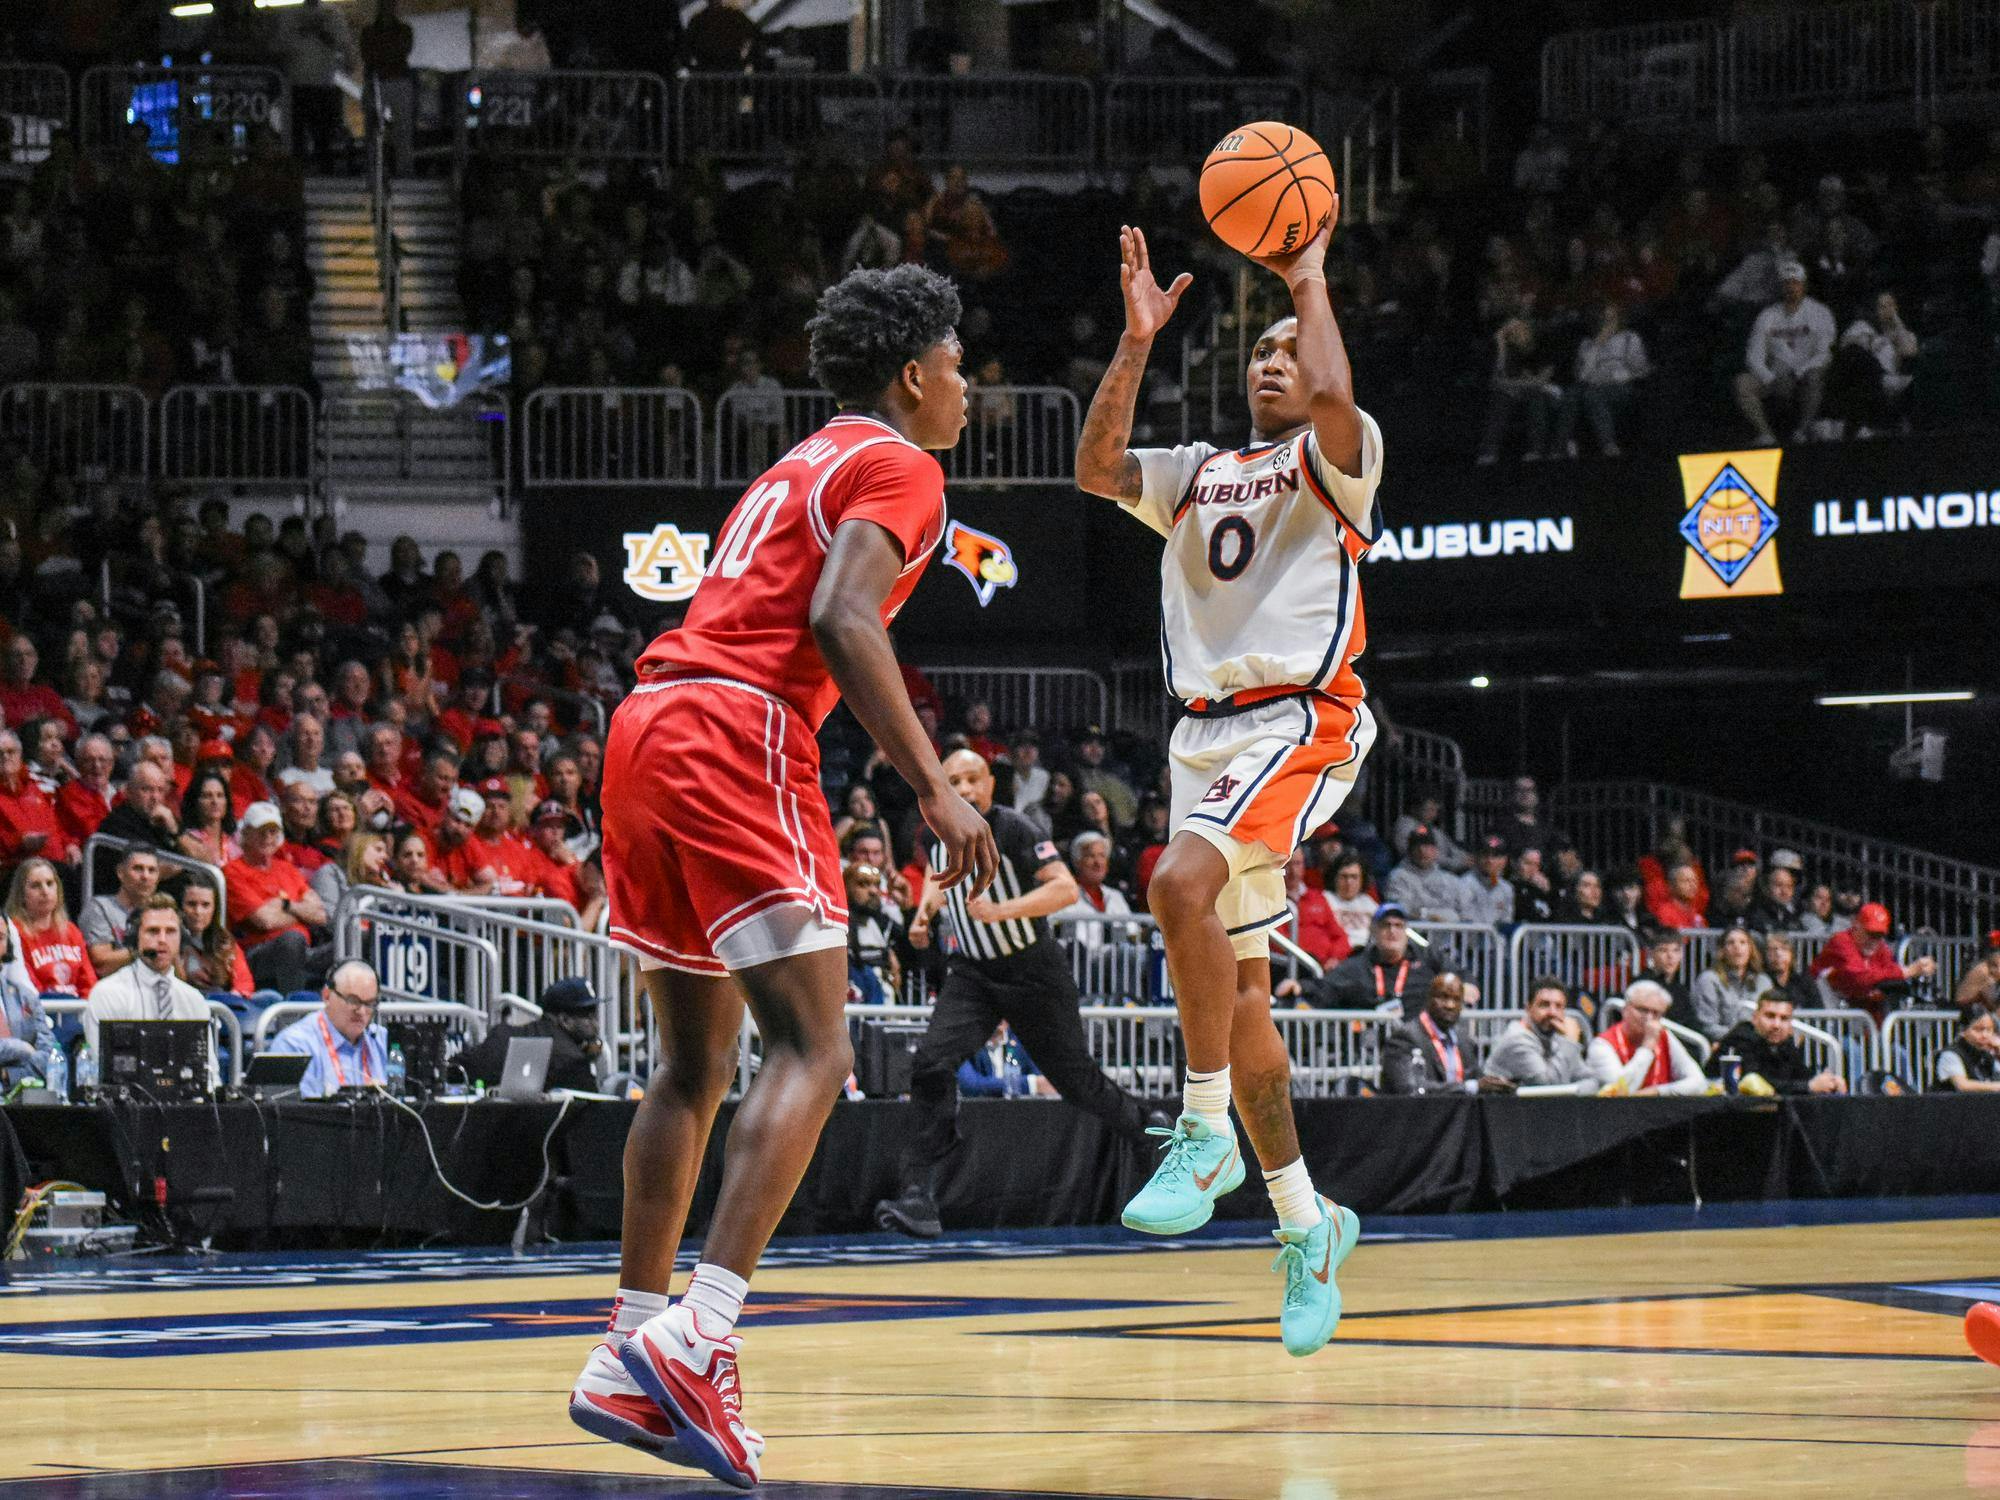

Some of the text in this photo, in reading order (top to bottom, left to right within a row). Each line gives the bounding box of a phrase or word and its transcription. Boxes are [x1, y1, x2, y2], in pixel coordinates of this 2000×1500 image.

[704, 480, 788, 579] 10
[1208, 514, 1256, 582] 0
[1367, 517, 1573, 563] AUBURN
[1703, 514, 1755, 536] NIT
